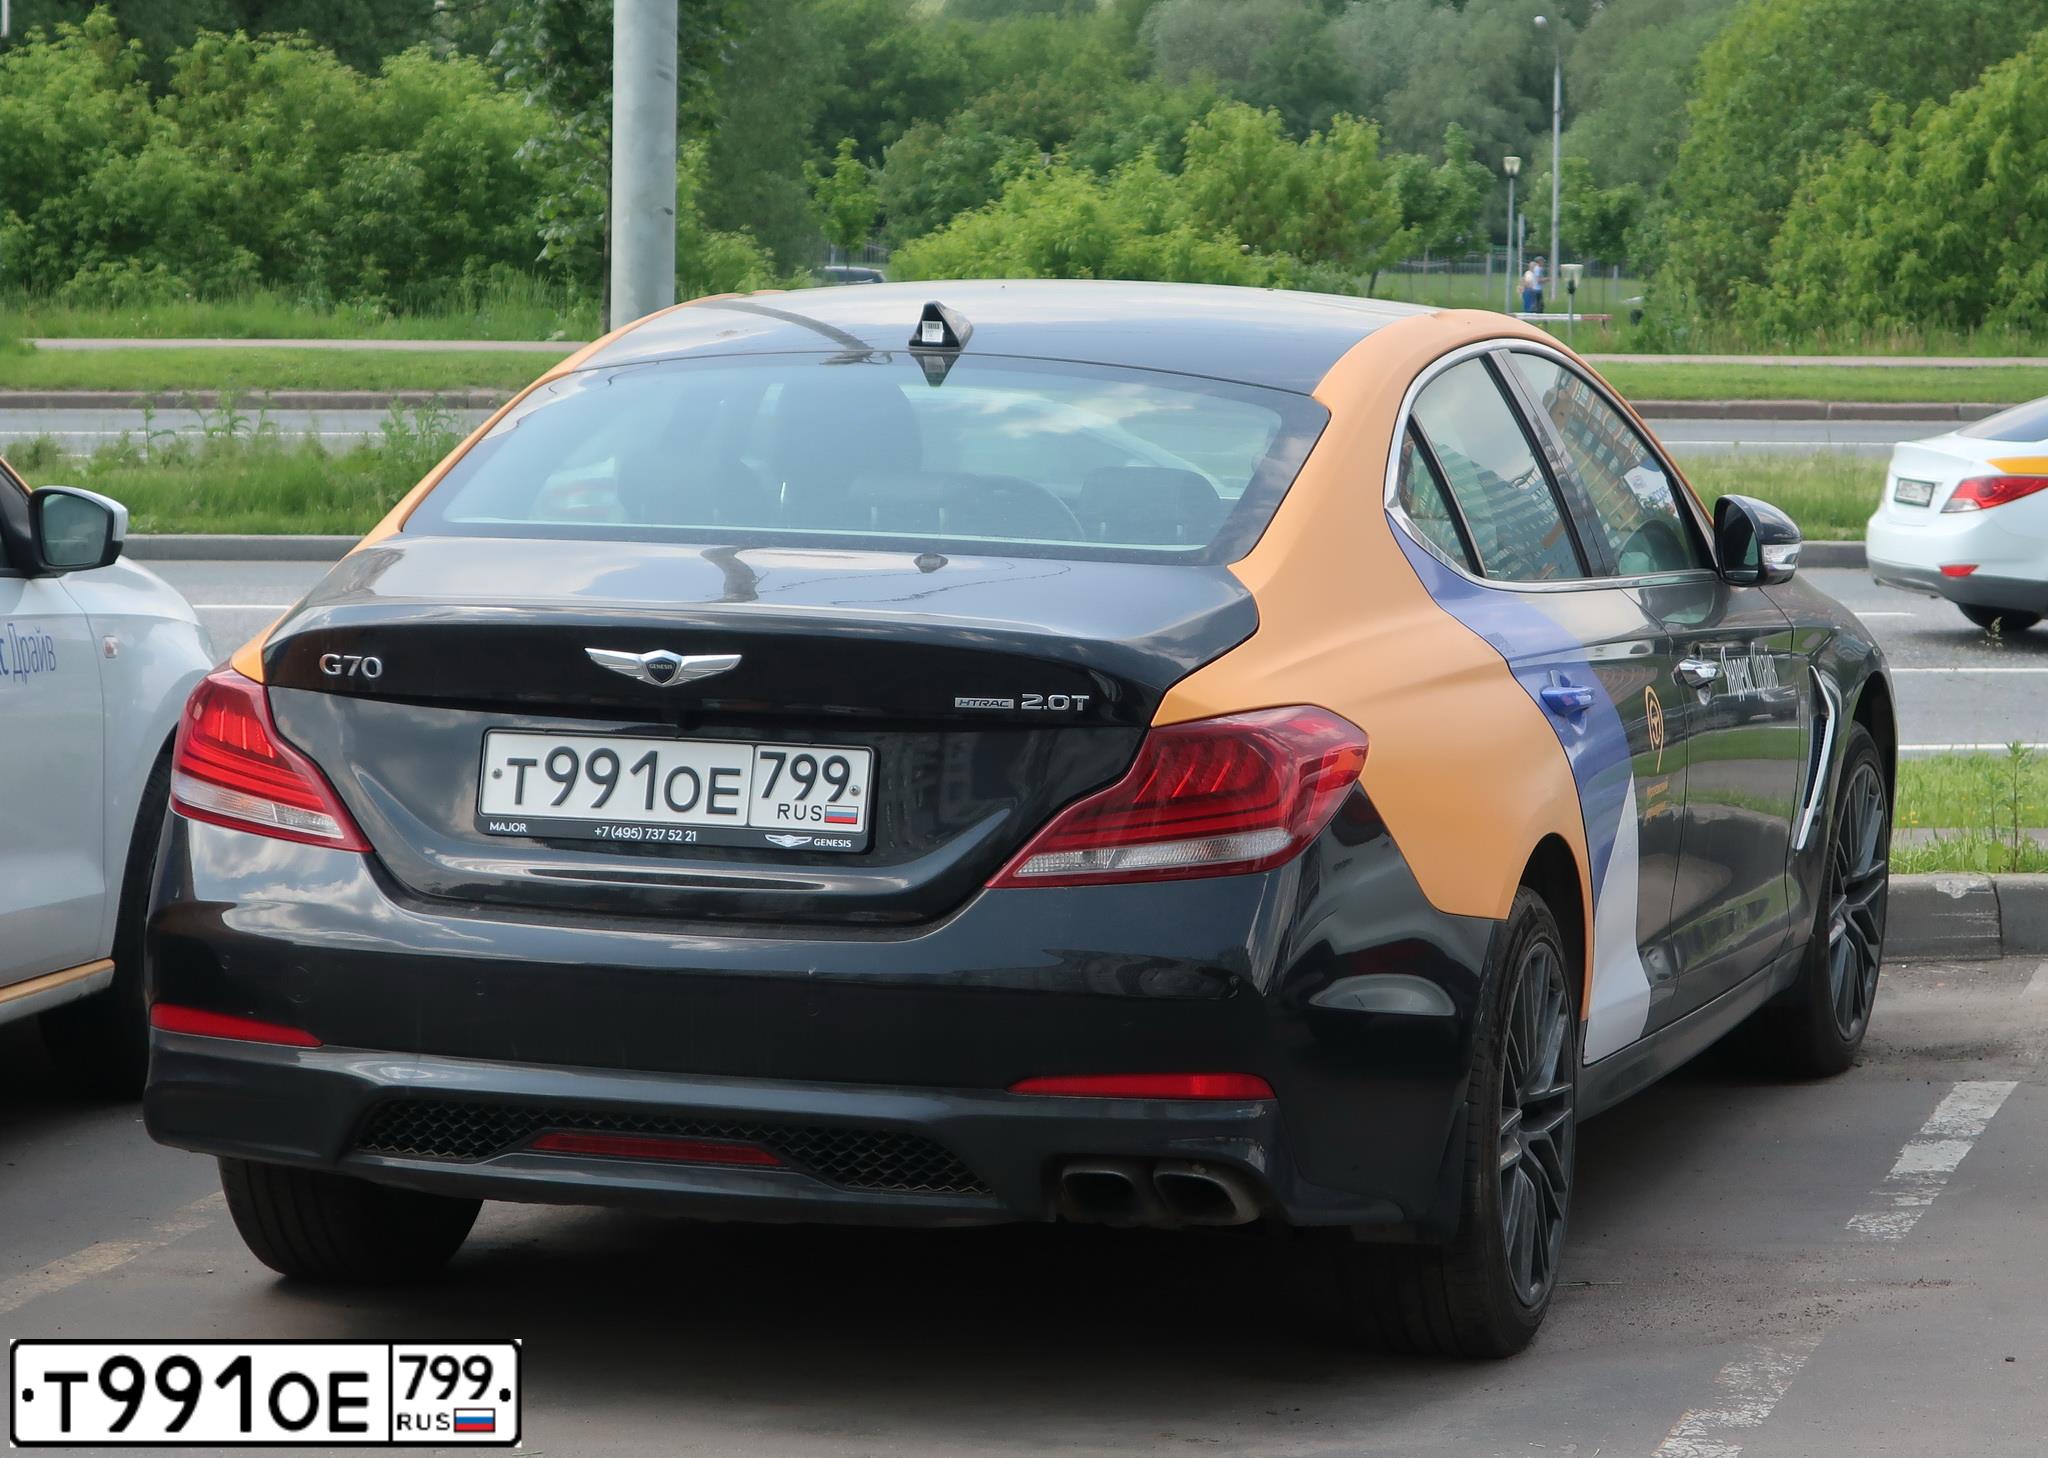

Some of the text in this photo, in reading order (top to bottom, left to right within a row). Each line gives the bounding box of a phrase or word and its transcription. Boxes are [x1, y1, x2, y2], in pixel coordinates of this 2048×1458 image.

[7, 623, 56, 685] Драйв
[319, 653, 383, 678] G70
[958, 693, 1090, 711] HTRAC 2.0T
[760, 751, 851, 802] 799
[777, 803, 823, 821] RUS
[489, 821, 527, 833] MAJOR
[594, 825, 697, 842] +7 (495) 737 52 21
[814, 838, 852, 848] GENESIS
